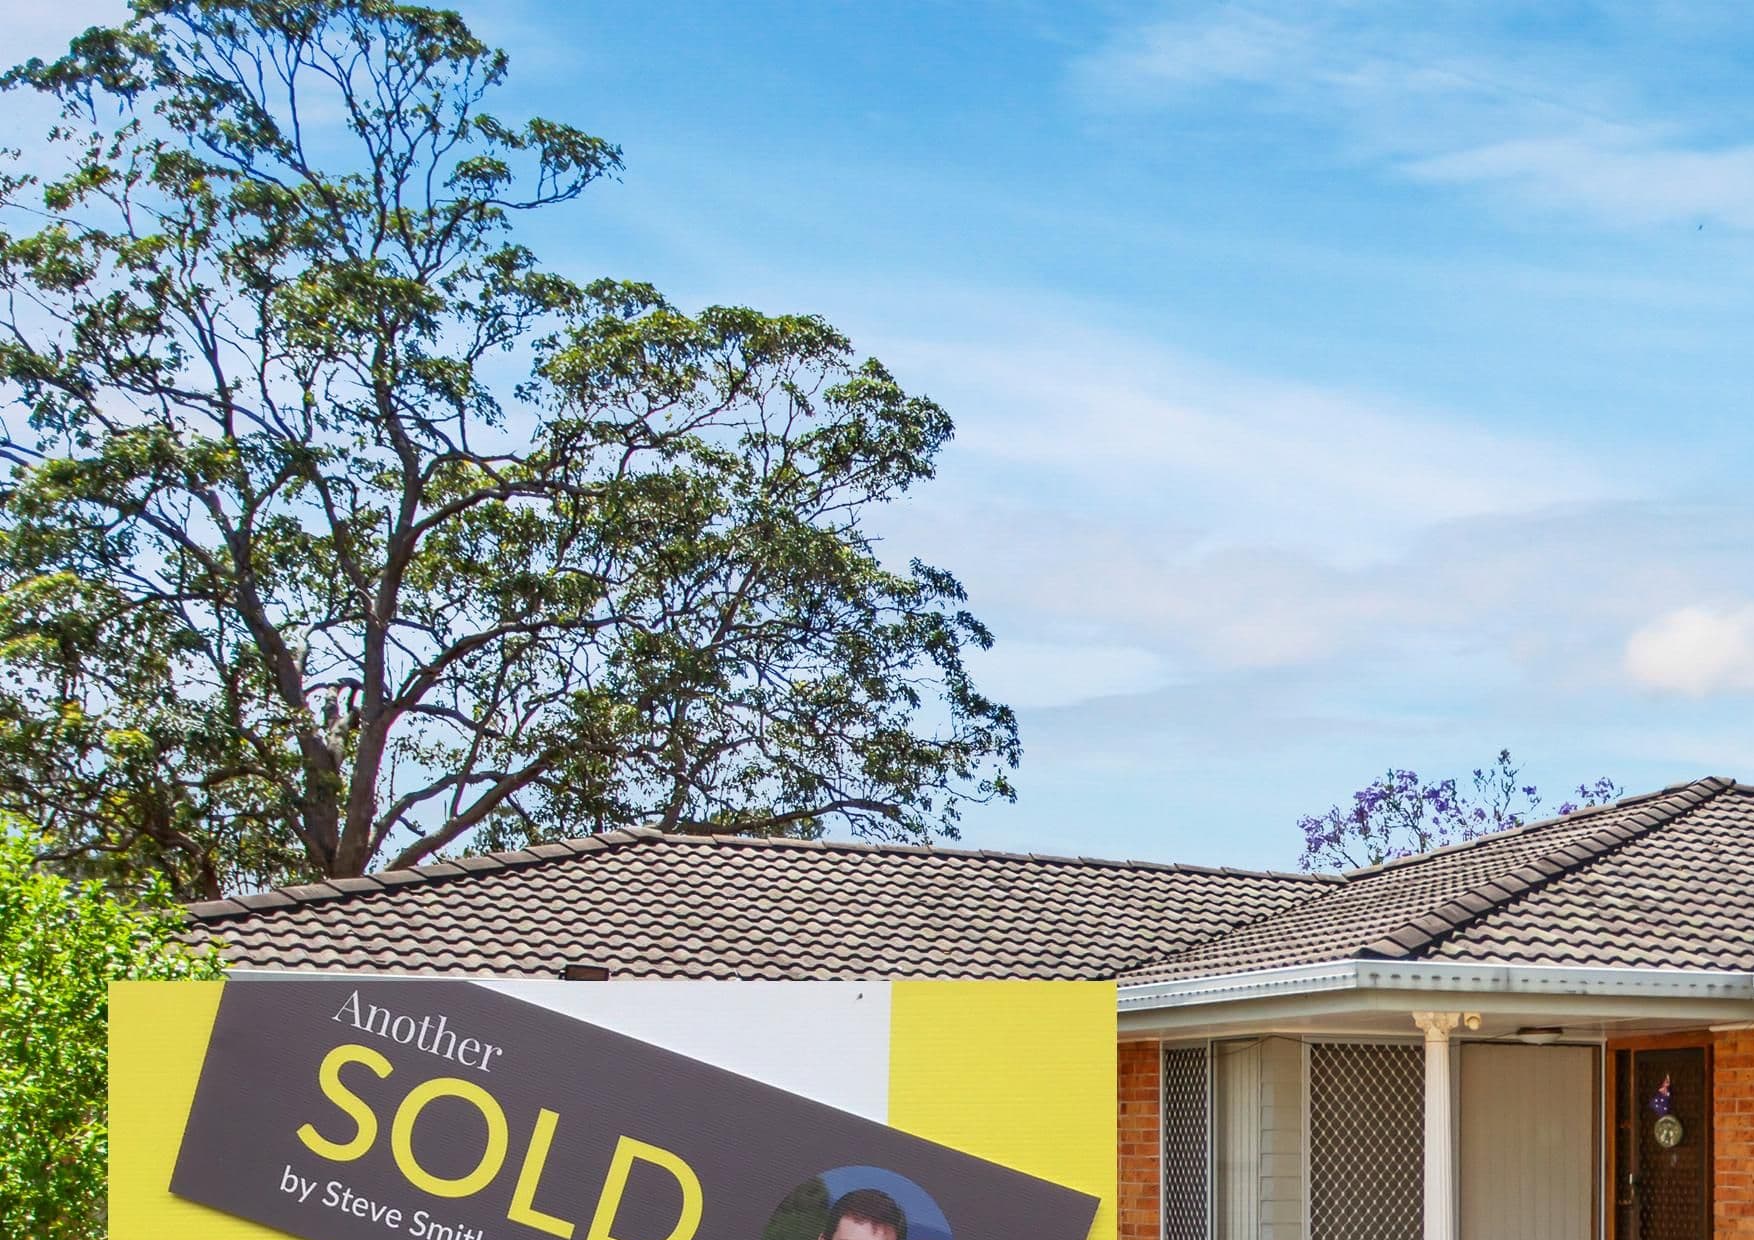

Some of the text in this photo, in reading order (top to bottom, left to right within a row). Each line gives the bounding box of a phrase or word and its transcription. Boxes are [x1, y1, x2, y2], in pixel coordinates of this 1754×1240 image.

[332, 990, 502, 1072] Another
[280, 1165, 317, 1202] by
[322, 1181, 402, 1228] Steve
